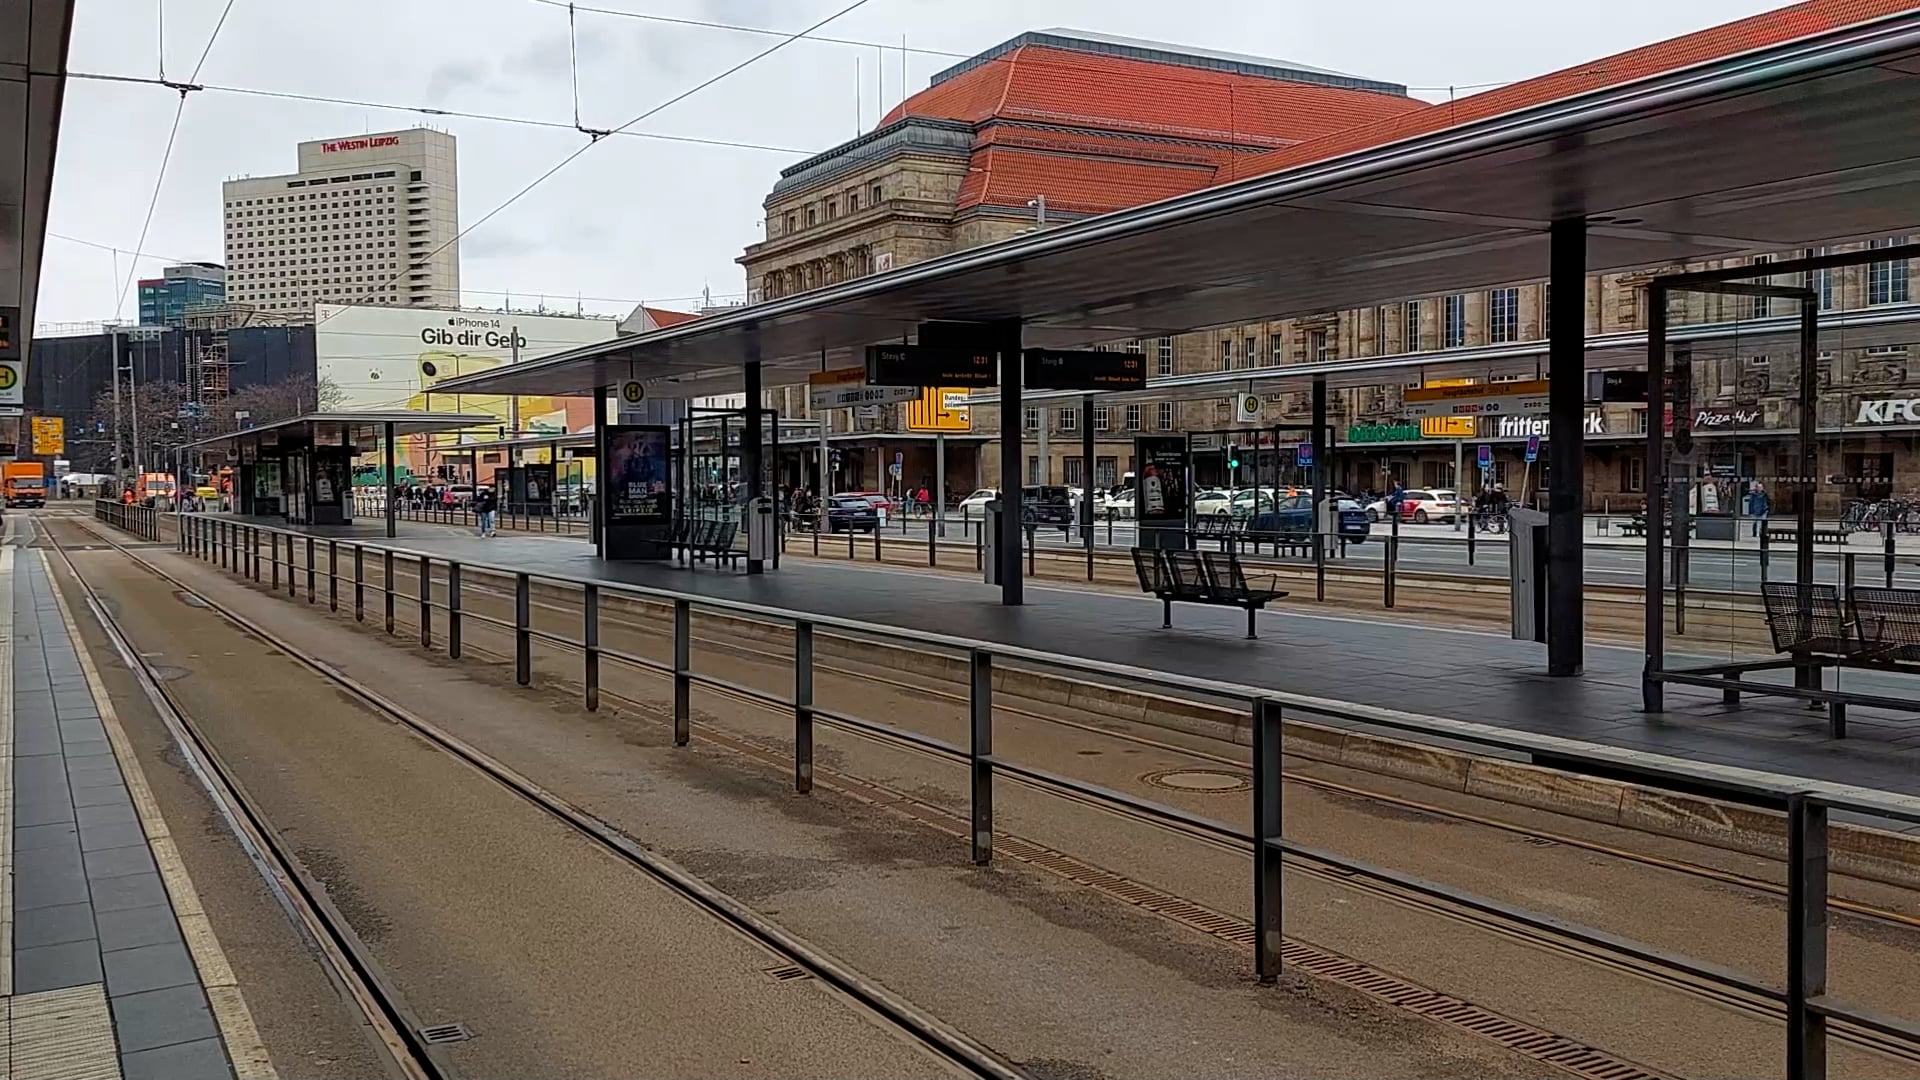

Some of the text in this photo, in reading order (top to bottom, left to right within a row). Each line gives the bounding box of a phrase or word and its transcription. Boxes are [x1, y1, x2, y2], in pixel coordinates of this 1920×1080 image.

[321, 137, 399, 153] THE WESTIN LEIPZIG
[455, 317, 500, 328] iPhone 14
[421, 328, 453, 345] Gib
[457, 330, 481, 346] dir
[1694, 409, 1761, 428] Pizza Hut
[1855, 399, 1920, 424] KFC
[1500, 412, 1602, 437] frittenrk
[628, 487, 648, 495] MAN
